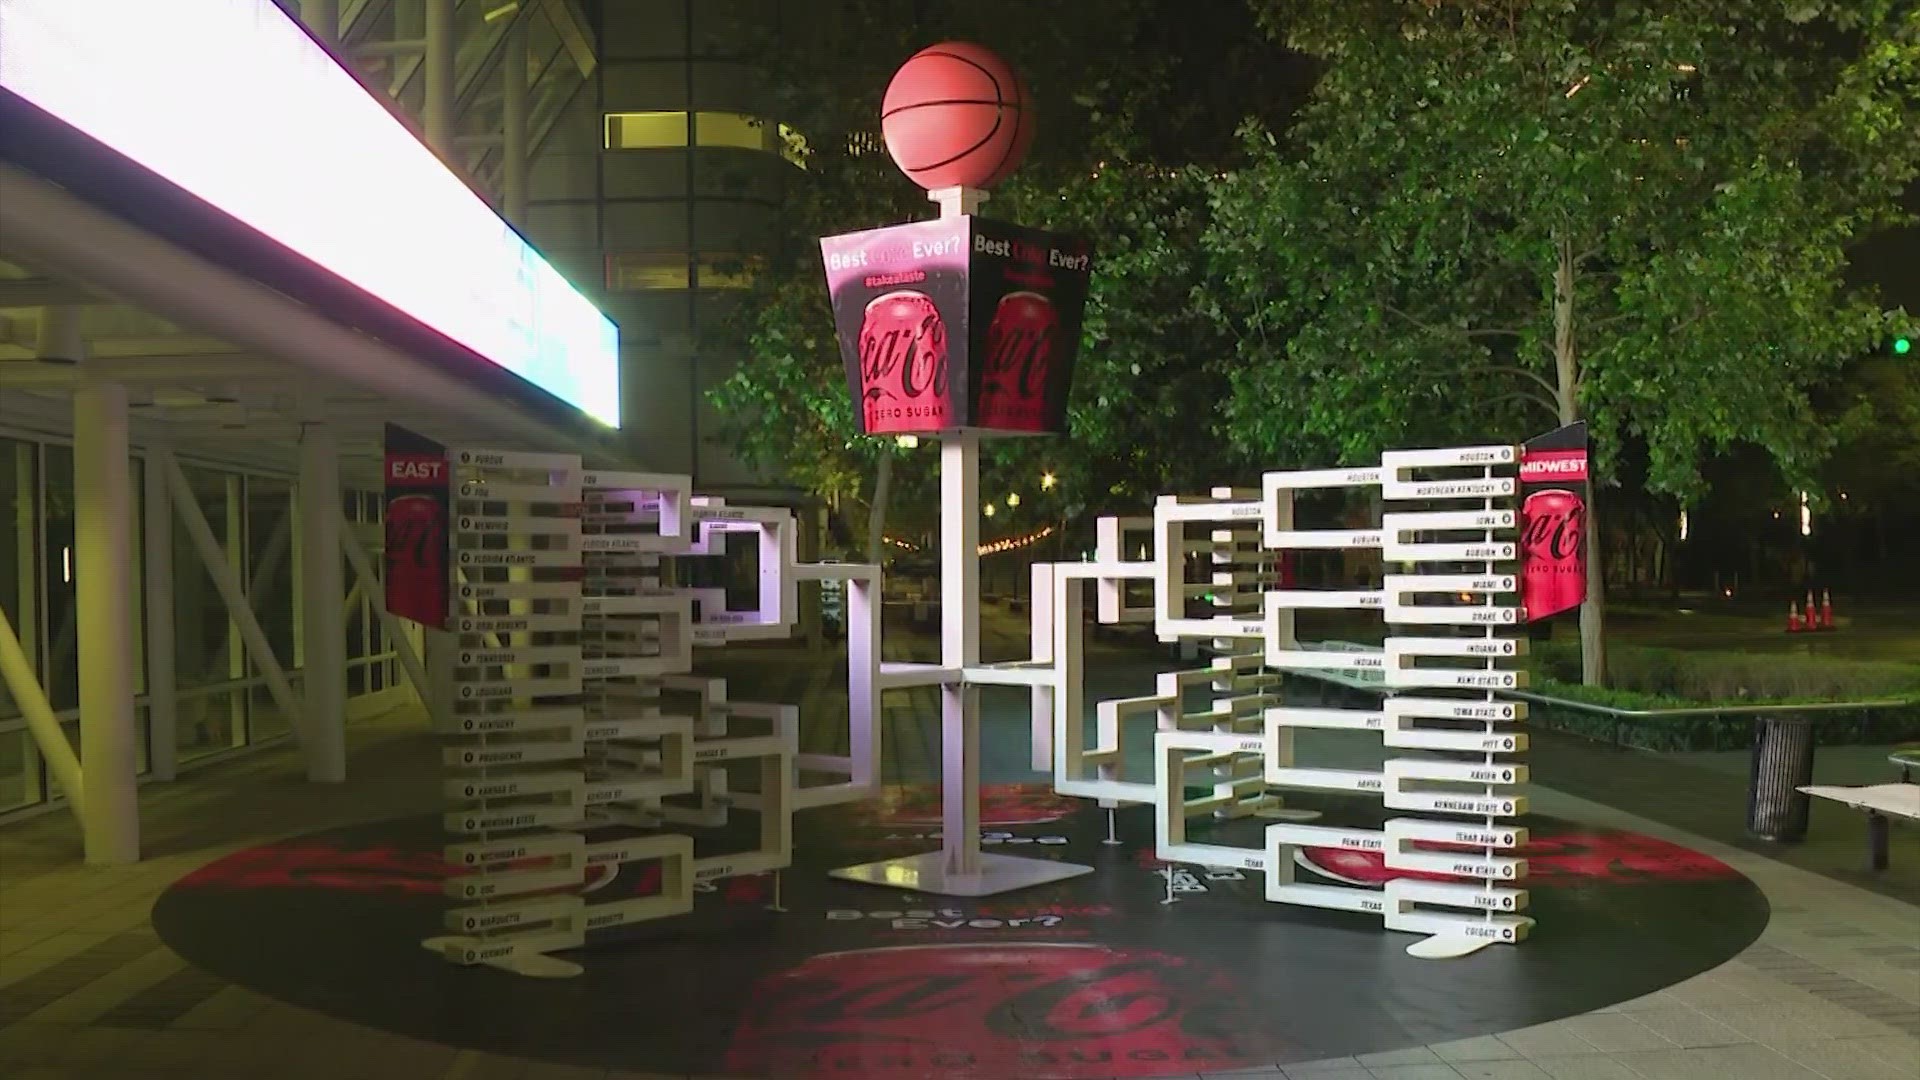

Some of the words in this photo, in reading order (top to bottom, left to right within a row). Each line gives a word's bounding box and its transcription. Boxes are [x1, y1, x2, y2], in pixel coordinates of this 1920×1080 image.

[830, 249, 868, 270] Best
[912, 236, 960, 258] Ever?
[974, 234, 1010, 257] Best
[1049, 249, 1089, 271] Ever?
[1460, 453, 1495, 461] HOUSTON
[392, 461, 441, 478] EAST
[1520, 459, 1587, 473] MIDWEST
[1476, 517, 1496, 525] IOWA
[1465, 548, 1496, 556] AUBURN
[474, 554, 503, 563] FLORIDA
[506, 555, 536, 563] ATLANTIC
[1472, 613, 1497, 621] DRAKE
[1482, 740, 1498, 748] PITT
[1361, 901, 1382, 911] TEXAS
[1475, 896, 1497, 906] TEXAS
[891, 915, 1064, 930] Ever?
